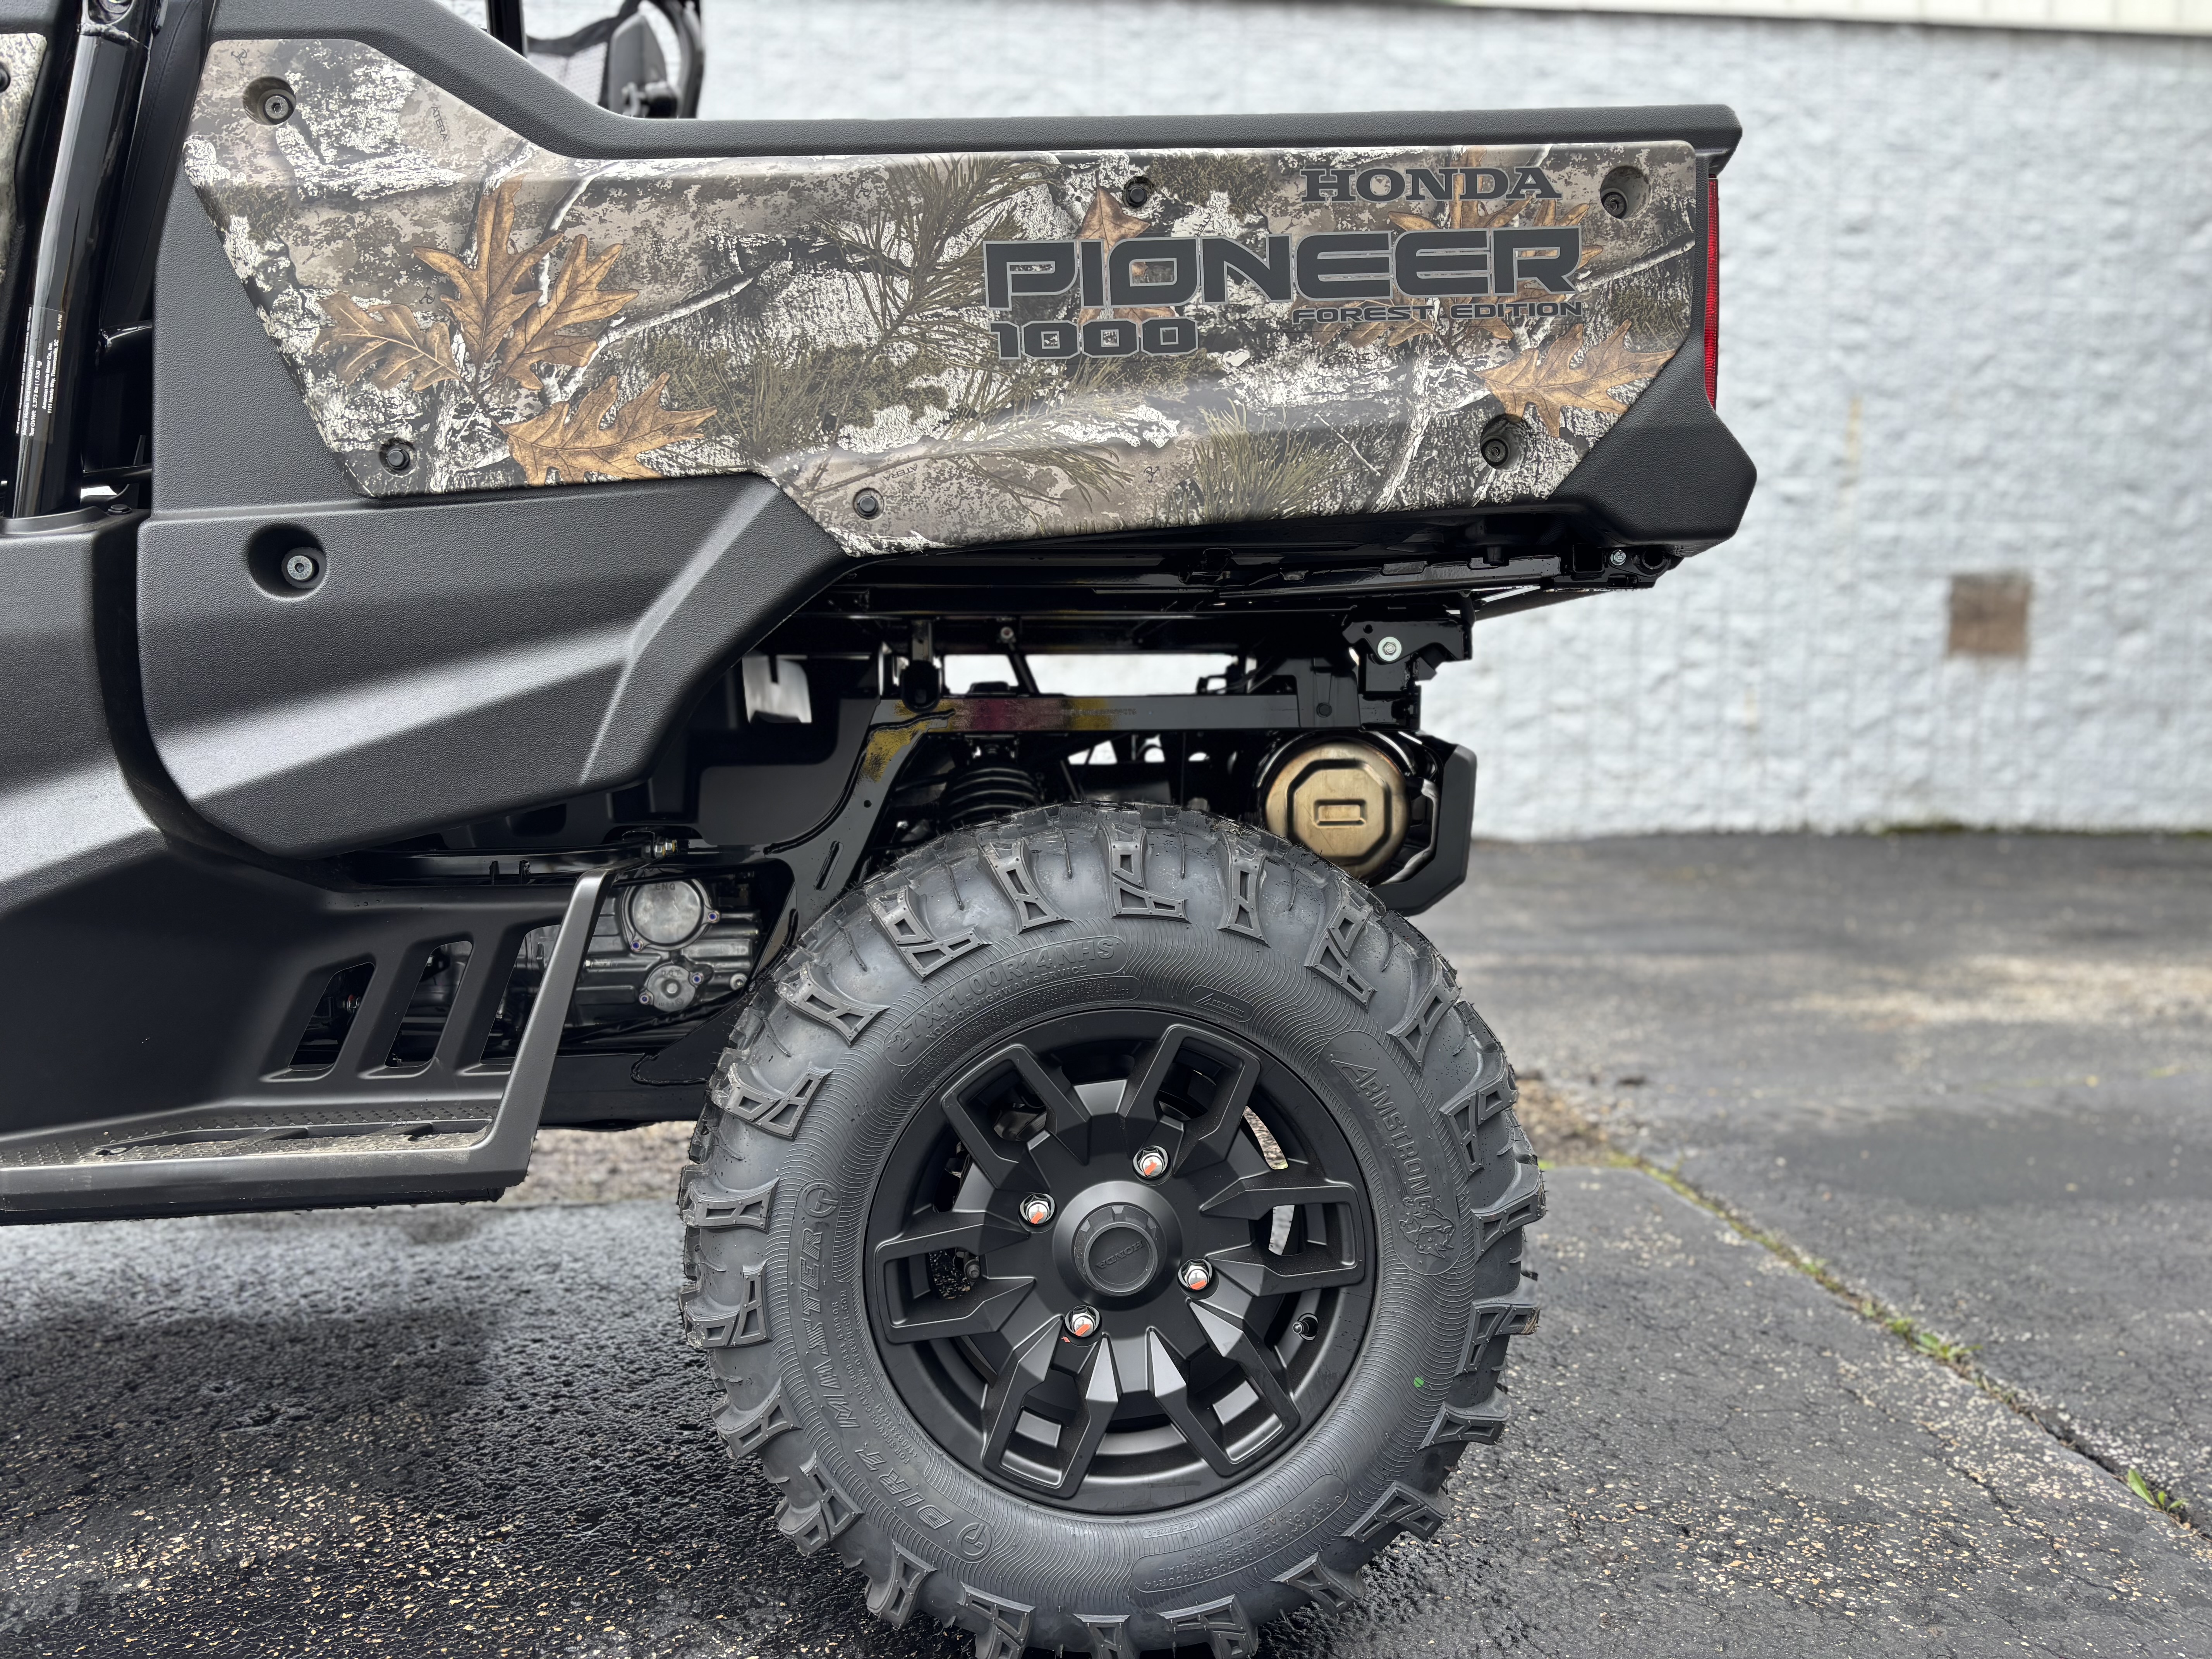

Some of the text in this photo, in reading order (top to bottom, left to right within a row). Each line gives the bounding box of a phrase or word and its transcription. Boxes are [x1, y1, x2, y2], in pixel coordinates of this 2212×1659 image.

[431, 106, 448, 142] ATERA
[1302, 167, 1562, 203] HONDA
[1194, 212, 1212, 237] ATER
[983, 225, 1583, 311] PIONEER
[1291, 300, 1583, 324] FOREST EDITION
[989, 316, 1198, 359] 1000
[883, 464, 918, 481] ATERA
[925, 1020, 951, 1042] NOT
[949, 1005, 974, 1024] FOR
[972, 978, 1031, 1010] HIGHWAY
[1032, 965, 1088, 984] SERVICE
[1211, 998, 1245, 1015] ROTATION
[1331, 1060, 1435, 1214] ARMSTRONG
[1096, 1240, 1144, 1269] HONDA
[830, 1301, 840, 1316] OR
[799, 1227, 954, 1530] DIRT MASTER
[867, 1411, 898, 1449] SERVICE
[893, 1446, 911, 1465] FOR
[1310, 1502, 1334, 1524] PLY
[1158, 1496, 1325, 1577] NYLON TUBELESS RADIAL
[1194, 1509, 1288, 1558] MADE IN CHINA
[1262, 1521, 1309, 1554] RATING
